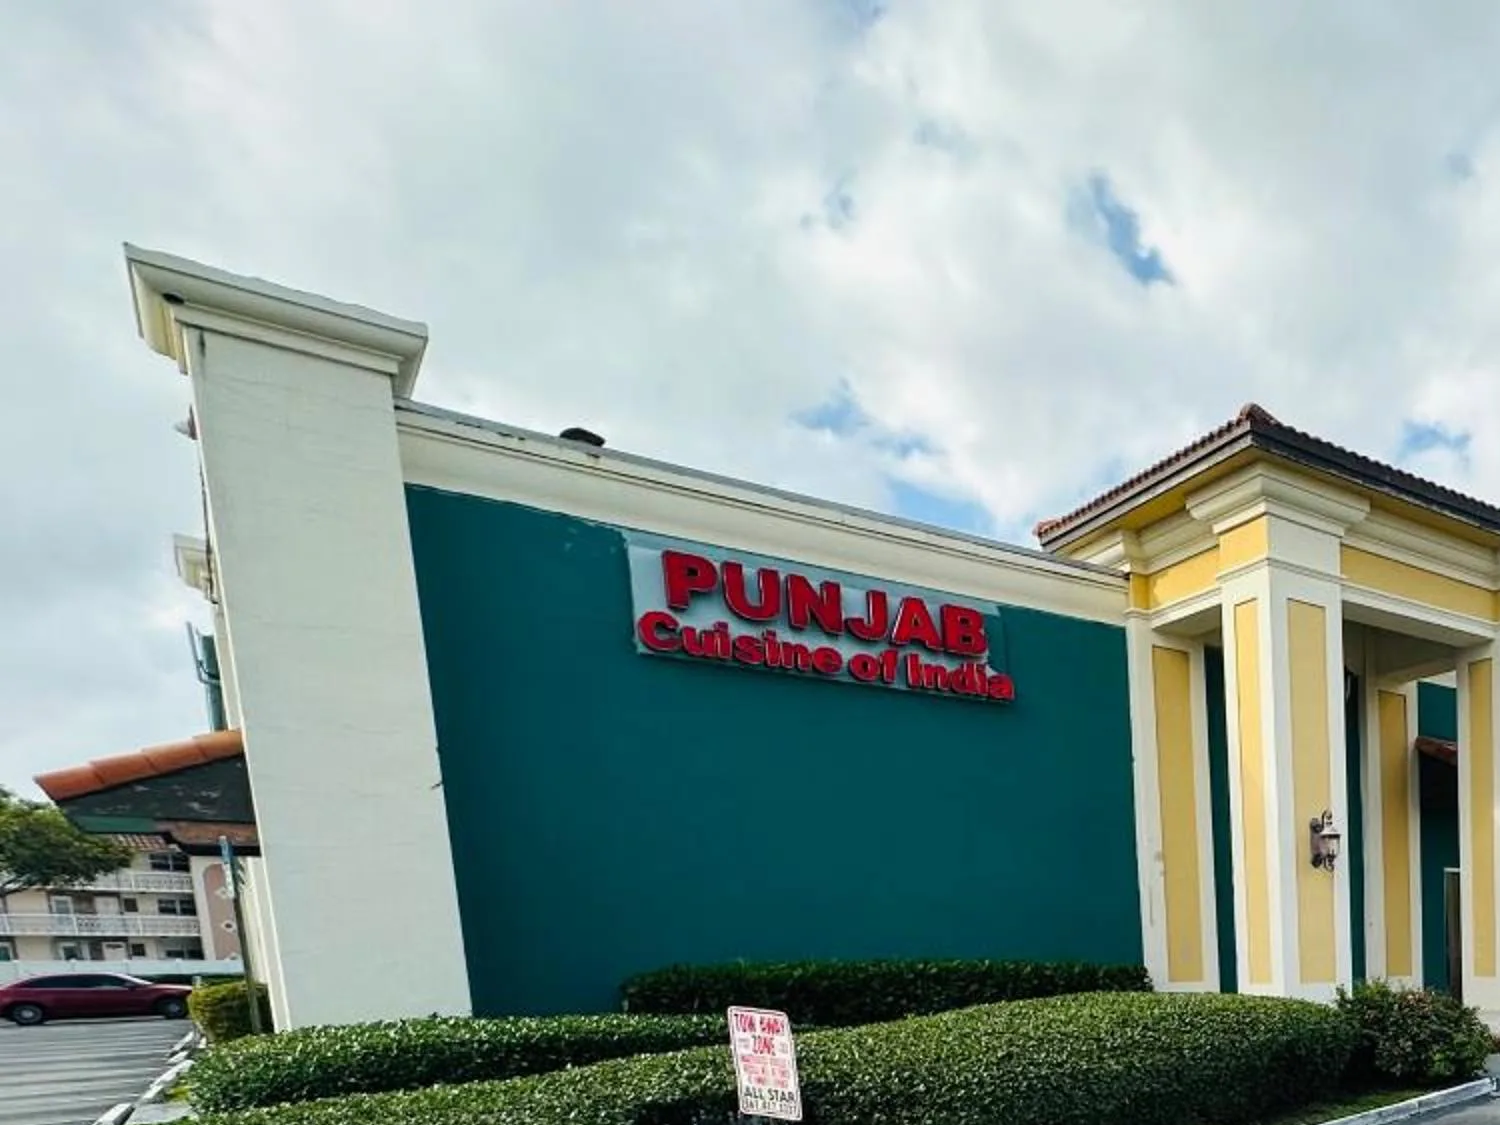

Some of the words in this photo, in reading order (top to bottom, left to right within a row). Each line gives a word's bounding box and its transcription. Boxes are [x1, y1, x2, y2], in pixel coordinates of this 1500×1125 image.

[661, 549, 989, 656] PUNJAB
[637, 610, 843, 674] Cuisine
[849, 649, 899, 684] of
[906, 652, 1015, 700] India
[752, 1035, 777, 1056] ZONE
[744, 1085, 765, 1099] ALL
[767, 1087, 795, 1103] STAR
